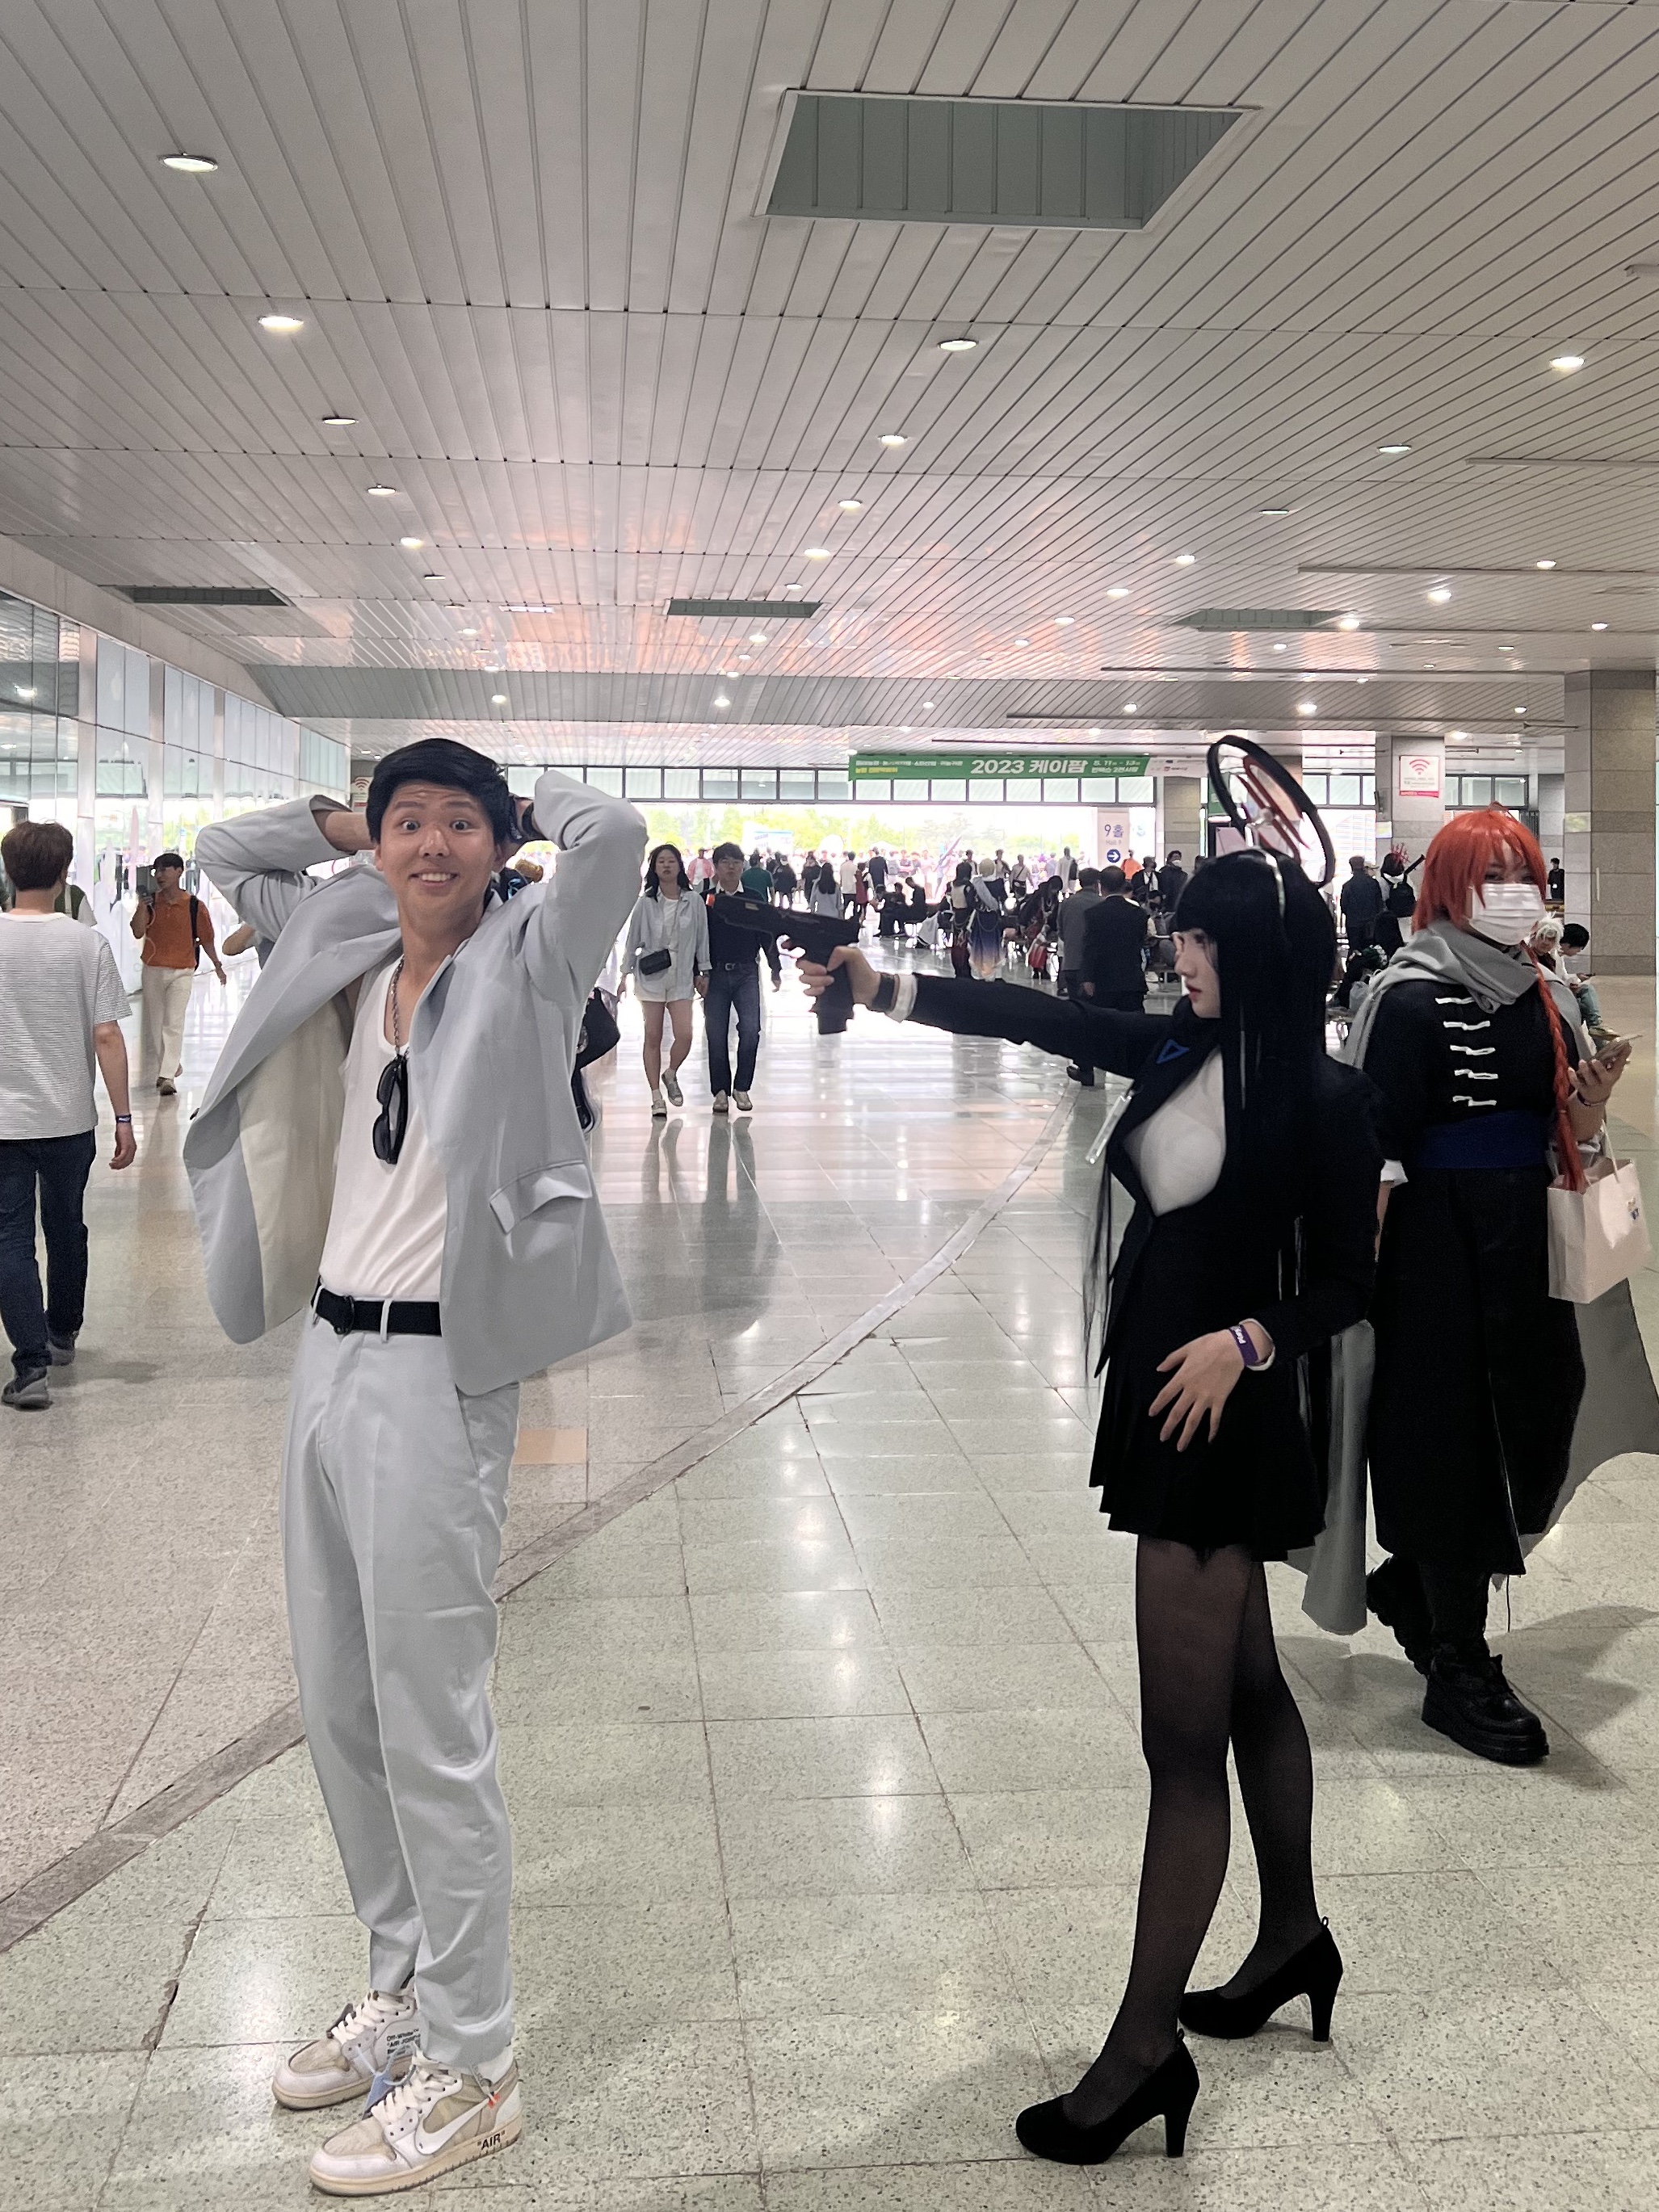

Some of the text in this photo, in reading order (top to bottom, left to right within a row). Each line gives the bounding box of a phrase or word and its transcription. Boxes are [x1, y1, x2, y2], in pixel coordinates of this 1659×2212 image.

[970, 759, 1025, 774] 2023
[1028, 759, 1088, 774] 케이팜
[477, 2129, 505, 2151] "AIR"
